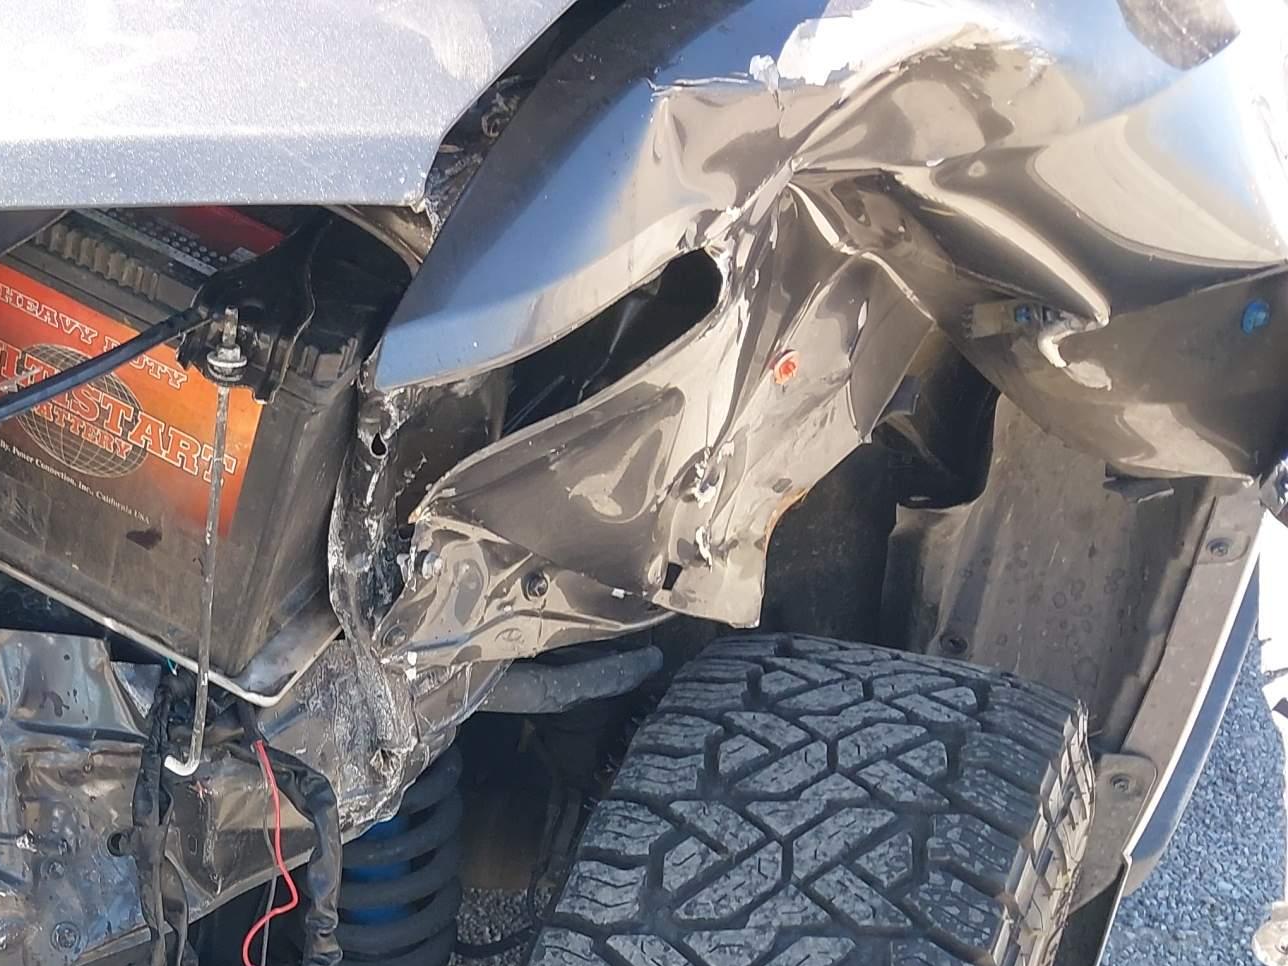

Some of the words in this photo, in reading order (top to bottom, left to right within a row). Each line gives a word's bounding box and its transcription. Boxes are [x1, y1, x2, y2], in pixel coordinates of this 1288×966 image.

[30, 400, 133, 461] ATTERY
[12, 445, 34, 464] Power
[95, 490, 133, 516] California
